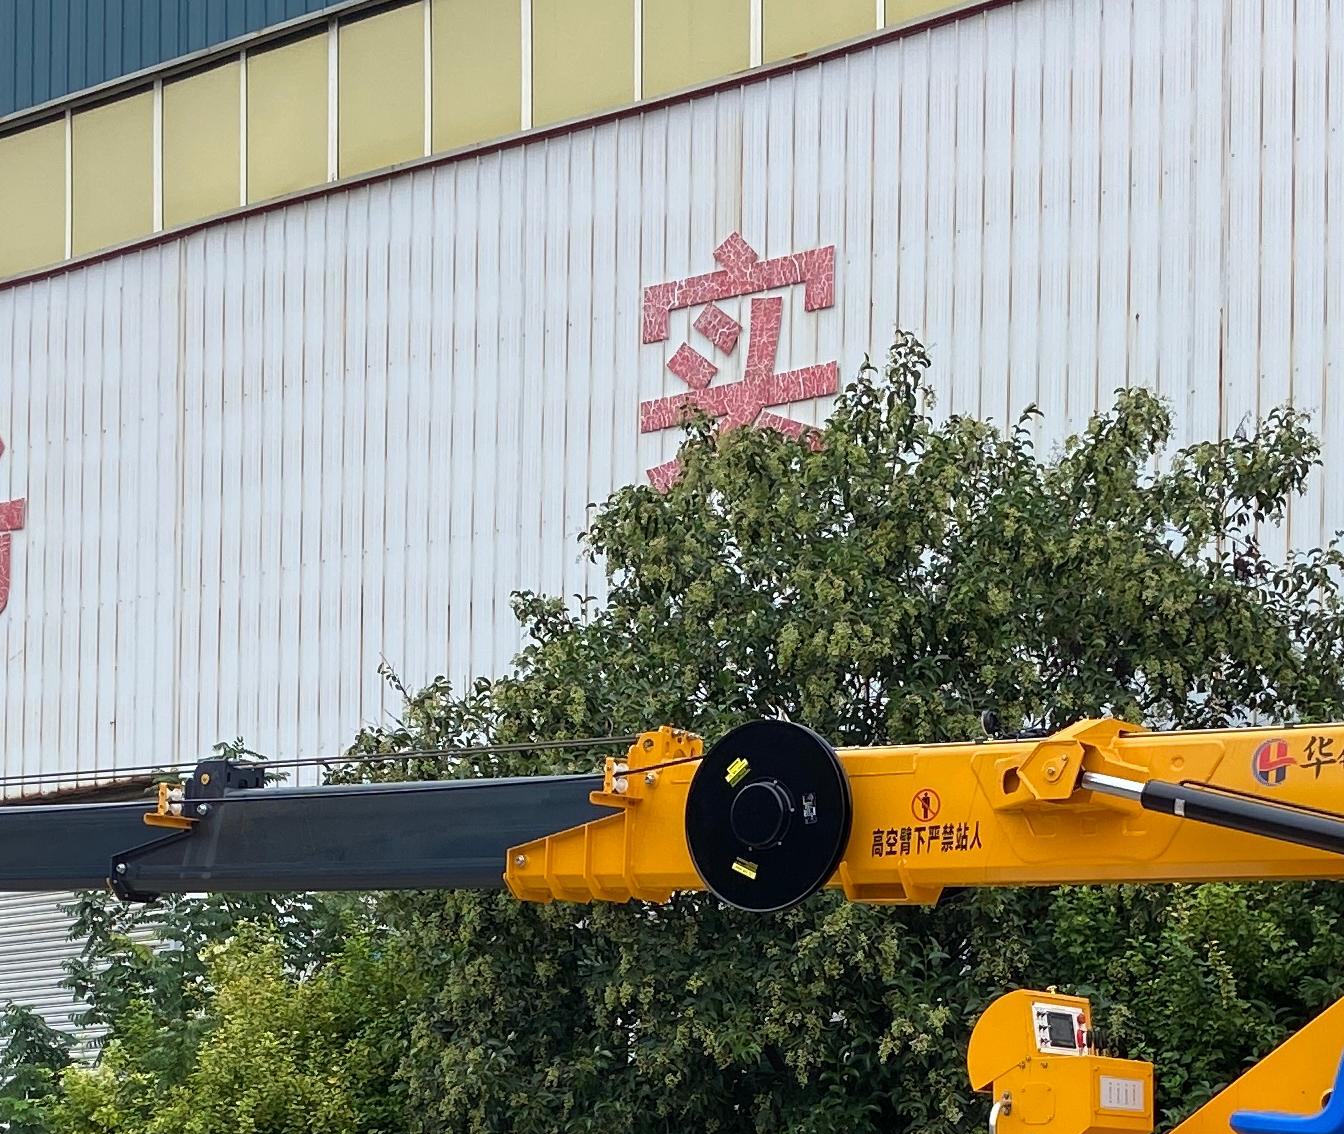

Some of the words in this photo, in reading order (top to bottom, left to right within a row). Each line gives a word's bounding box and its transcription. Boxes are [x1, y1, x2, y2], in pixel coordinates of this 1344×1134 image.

[640, 232, 839, 494] 实
[871, 820, 982, 858] 高空臂下严禁站人
